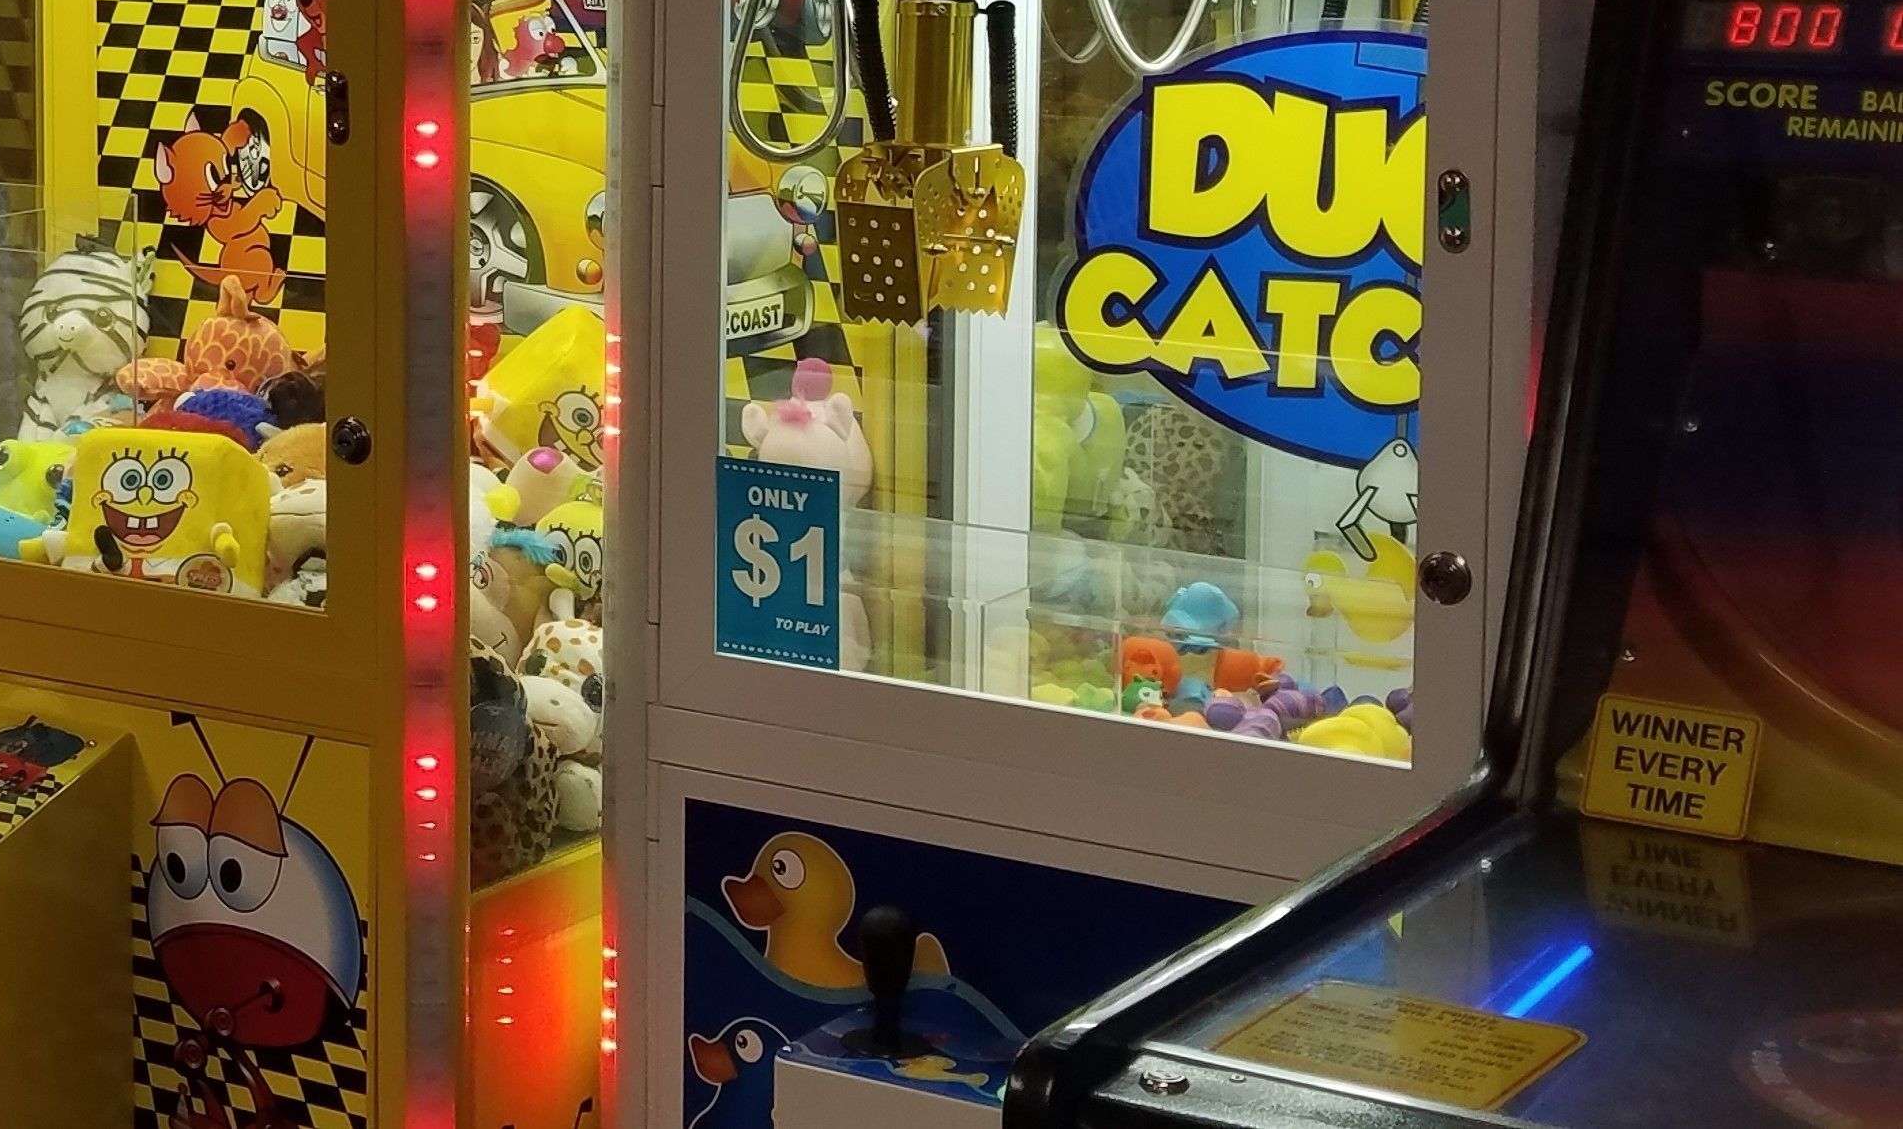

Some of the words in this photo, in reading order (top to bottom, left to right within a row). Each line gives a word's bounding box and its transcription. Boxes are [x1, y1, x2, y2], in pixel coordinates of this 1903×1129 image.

[1728, 5, 1844, 47] 800
[1705, 80, 1819, 110] SCORE
[727, 304, 781, 335] COAST
[747, 485, 809, 512] ONLY
[731, 513, 825, 608] $1
[775, 617, 793, 631] TO
[794, 619, 831, 637] PLAY
[1611, 707, 1746, 755] WINNER
[1613, 745, 1728, 787] EVERY
[1626, 781, 1707, 821] TIME
